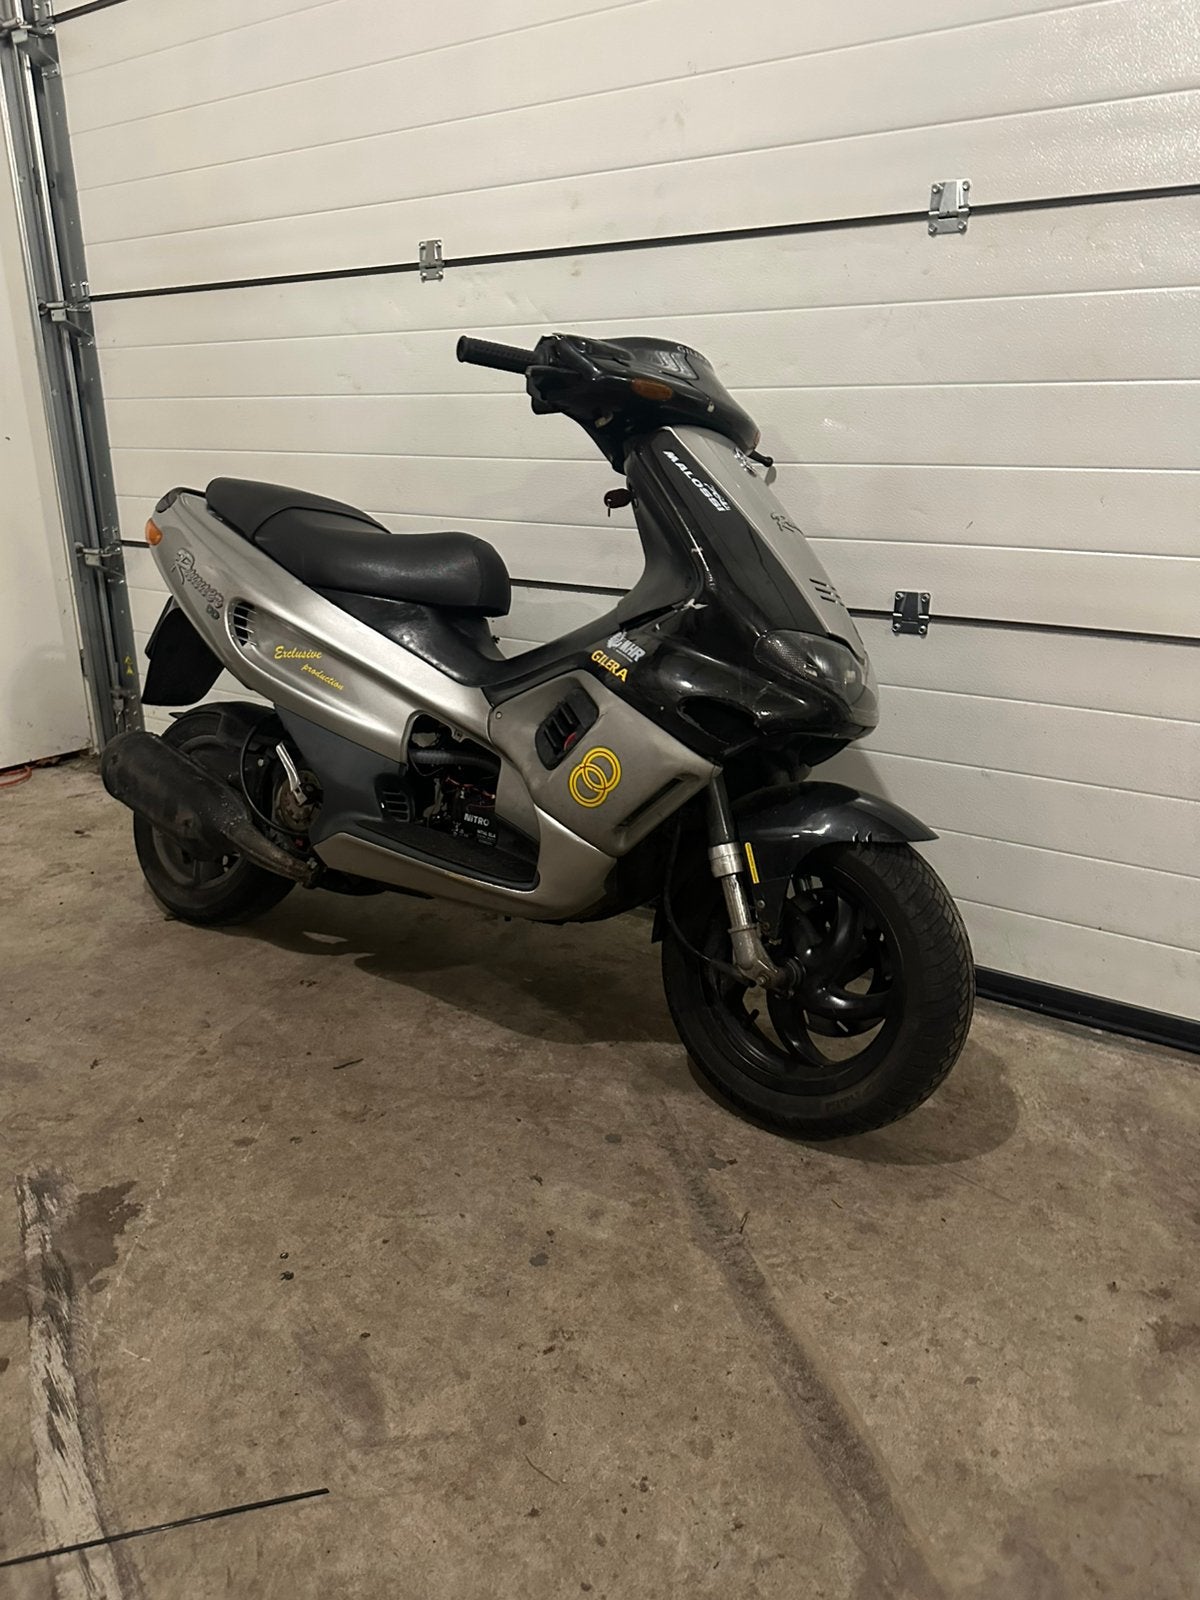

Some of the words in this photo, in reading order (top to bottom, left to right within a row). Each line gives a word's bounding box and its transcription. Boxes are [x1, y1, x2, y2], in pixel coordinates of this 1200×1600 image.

[662, 451, 727, 512] MALOSSI
[171, 547, 224, 609] Runner
[274, 645, 322, 660] Exclusive
[591, 650, 629, 683] GILERA
[301, 663, 345, 690] production
[464, 812, 490, 827] NITRO
